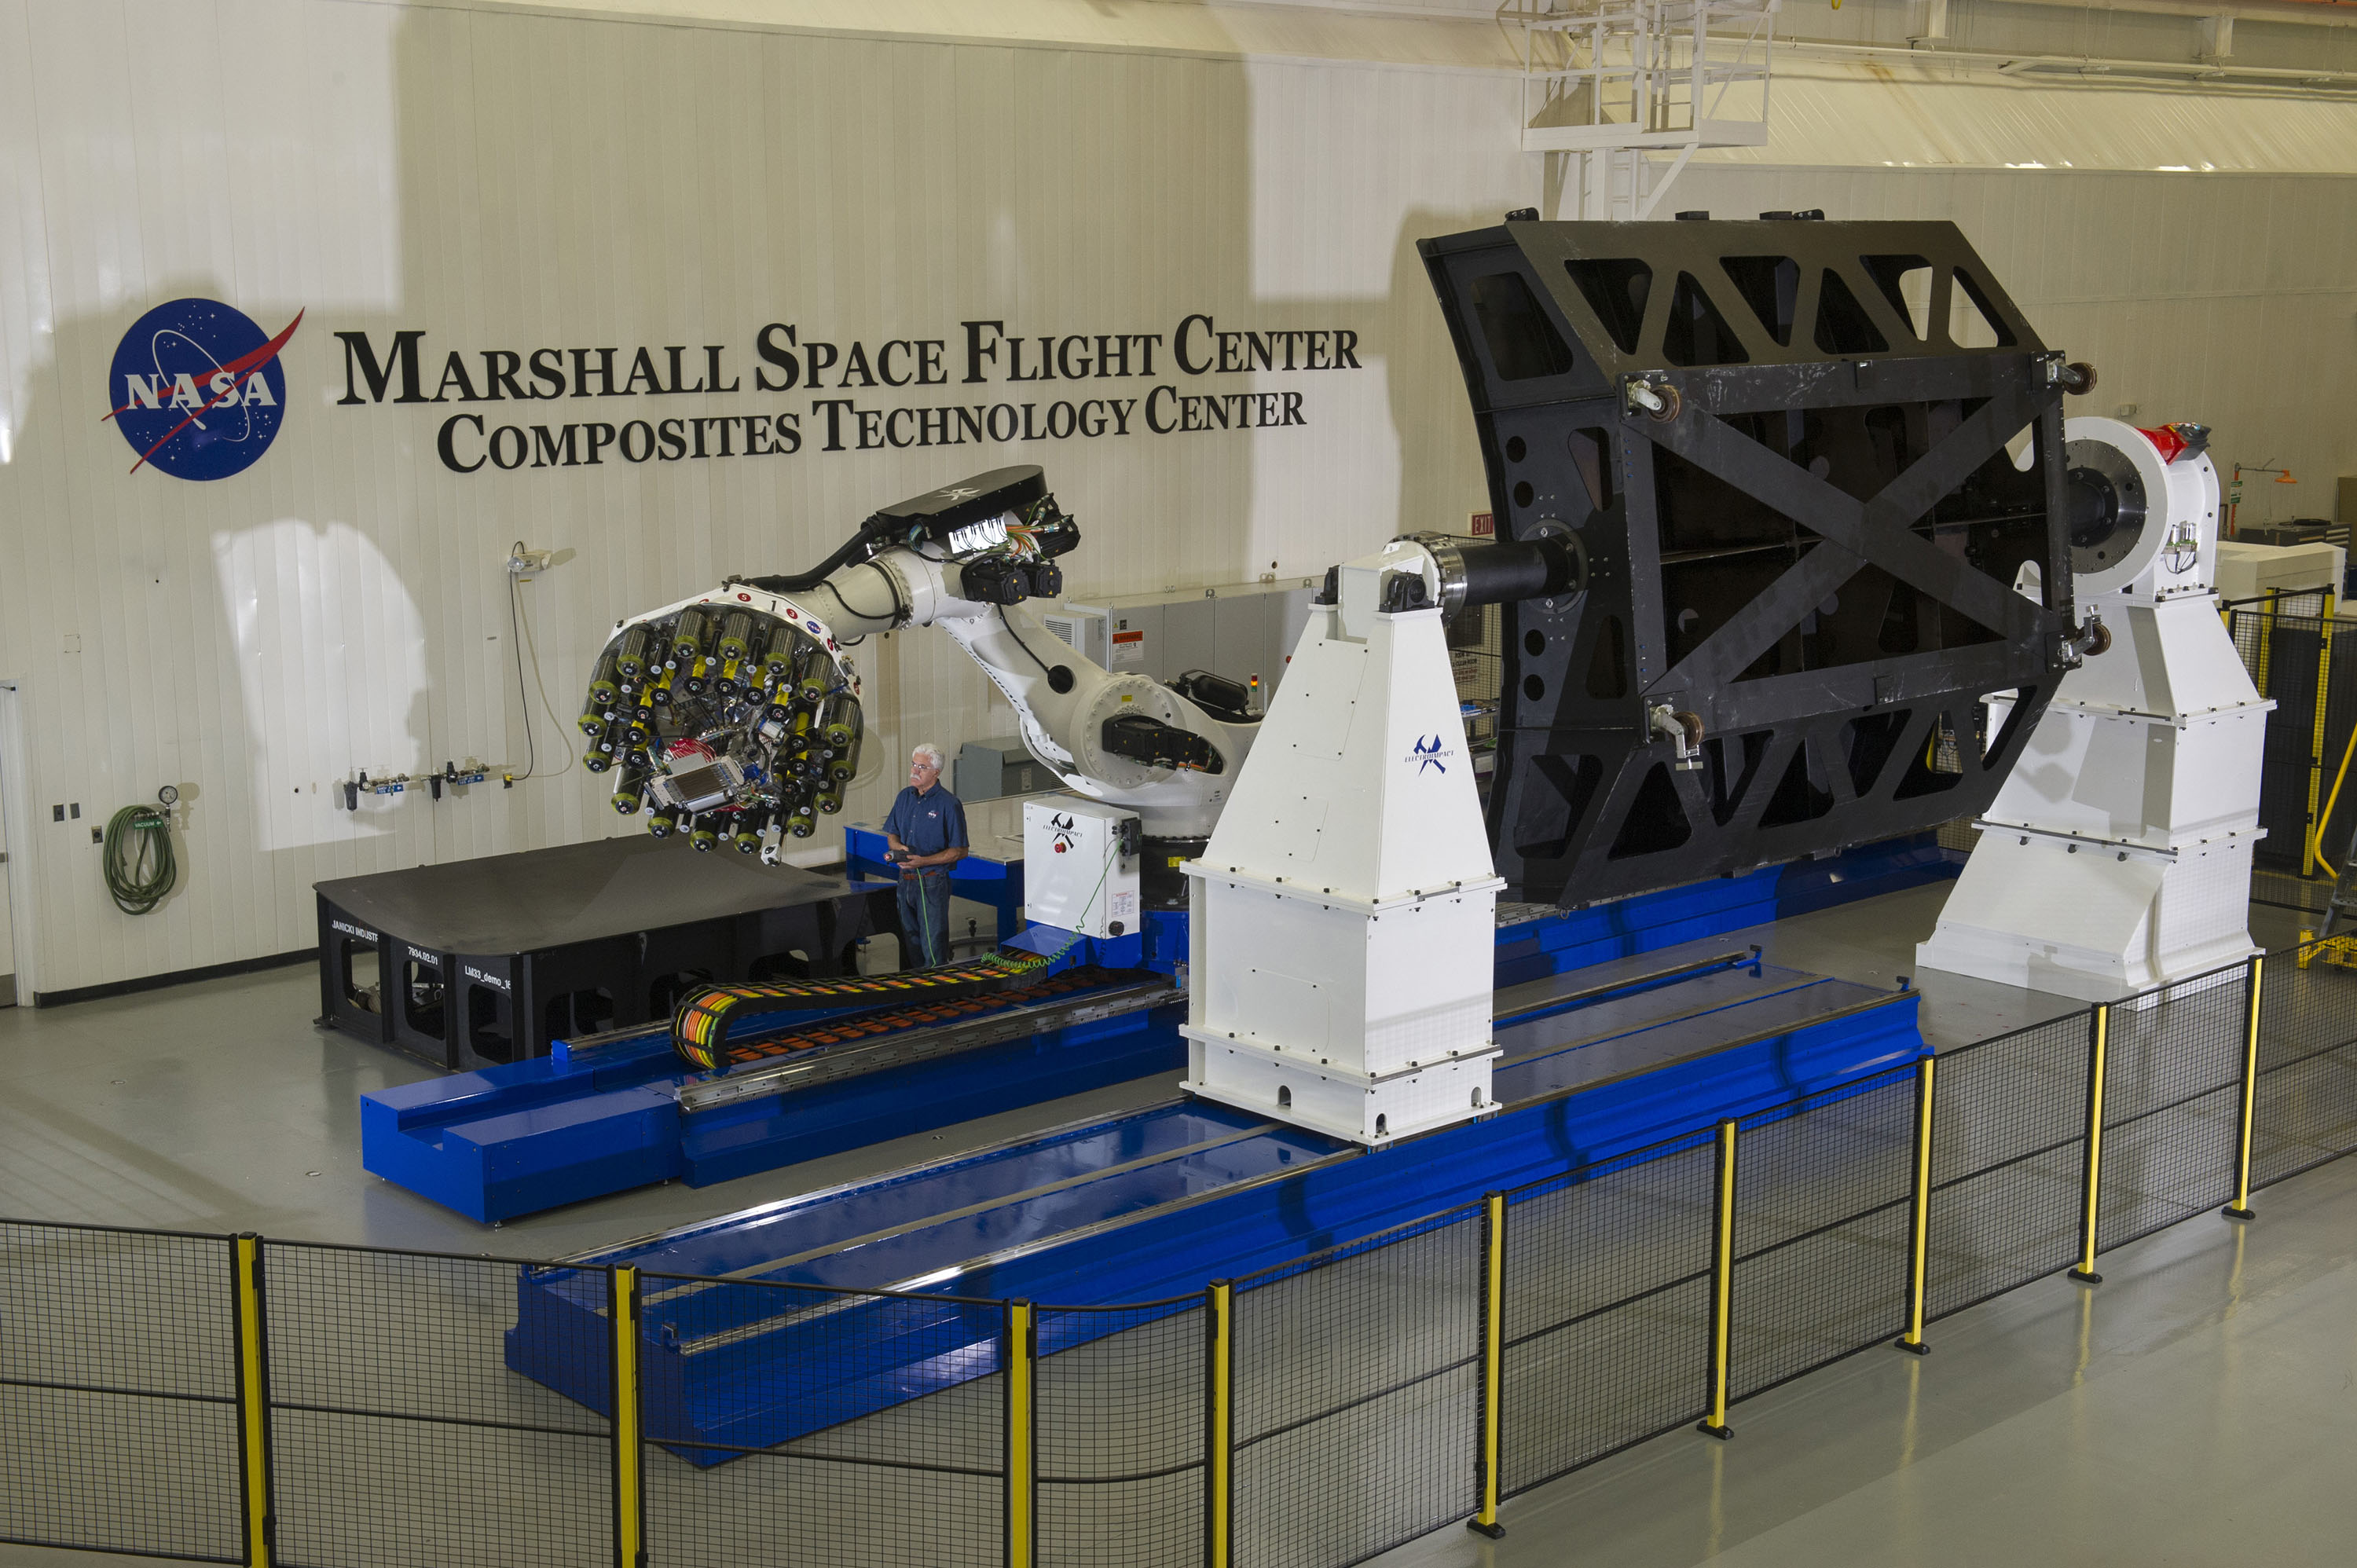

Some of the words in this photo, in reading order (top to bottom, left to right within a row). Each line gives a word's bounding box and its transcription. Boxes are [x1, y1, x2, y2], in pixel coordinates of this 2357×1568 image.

[334, 330, 740, 405] MARSHALL
[755, 323, 948, 392] SPACE
[960, 321, 1163, 383] FLIGHT
[1174, 313, 1362, 376] CENTER
[124, 371, 277, 409] NASA
[437, 412, 802, 473] COMPOSITES
[812, 398, 1138, 452] TECHNOLOGY
[1145, 385, 1307, 437] CENTER
[1475, 515, 1491, 534] EXIT
[332, 919, 355, 935] JANICKI
